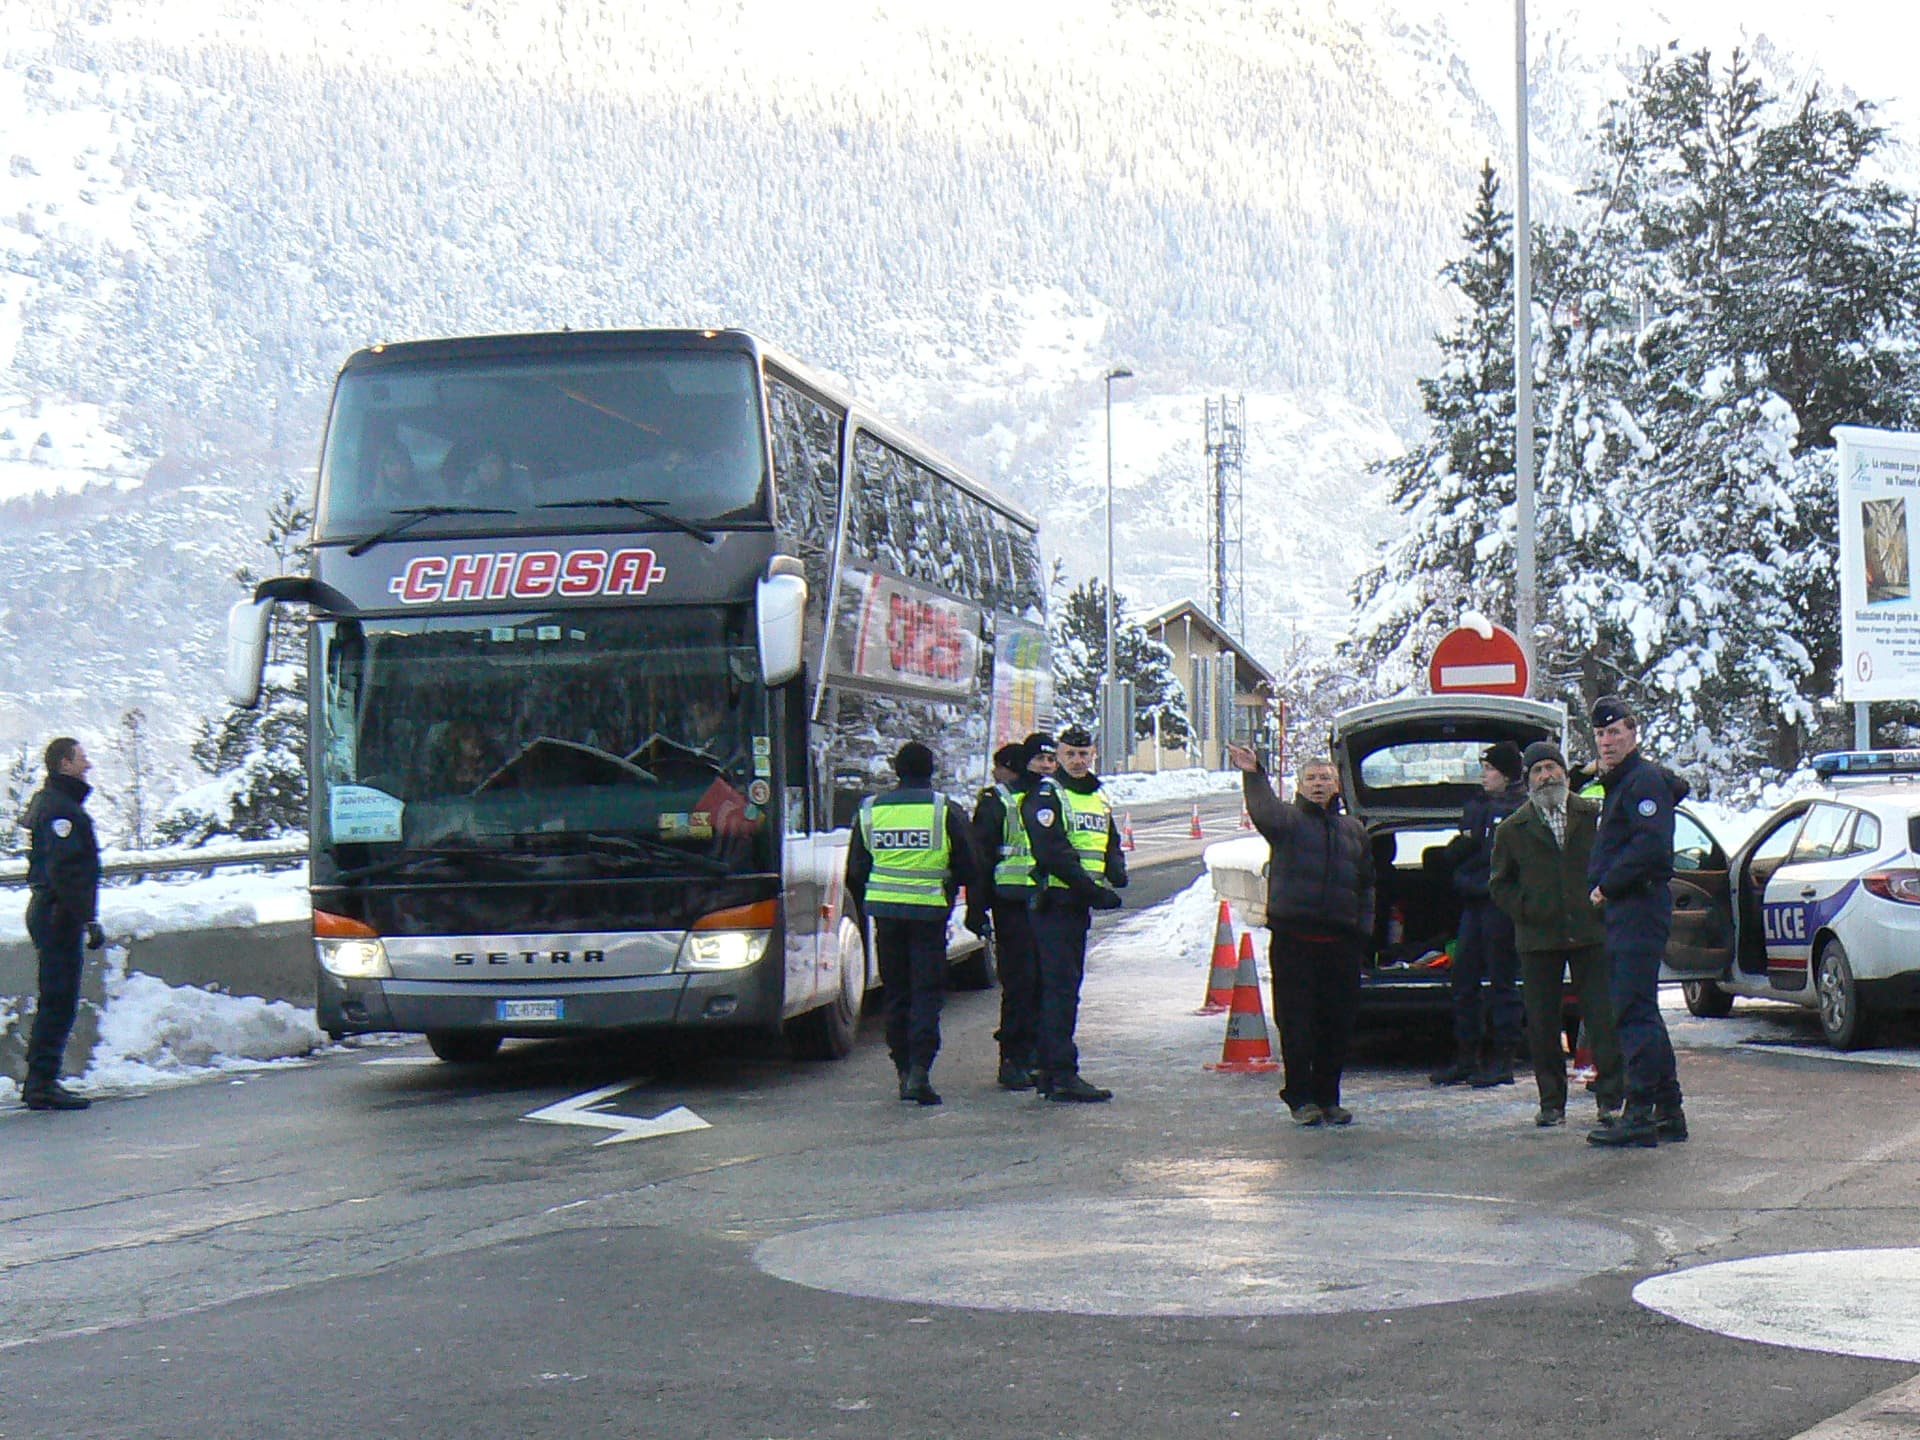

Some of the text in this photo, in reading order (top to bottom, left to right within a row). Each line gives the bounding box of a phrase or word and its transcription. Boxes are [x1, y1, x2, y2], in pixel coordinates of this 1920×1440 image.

[872, 831, 929, 847] POLICE
[1763, 907, 1806, 939] LICE
[454, 951, 605, 965] SETRA
